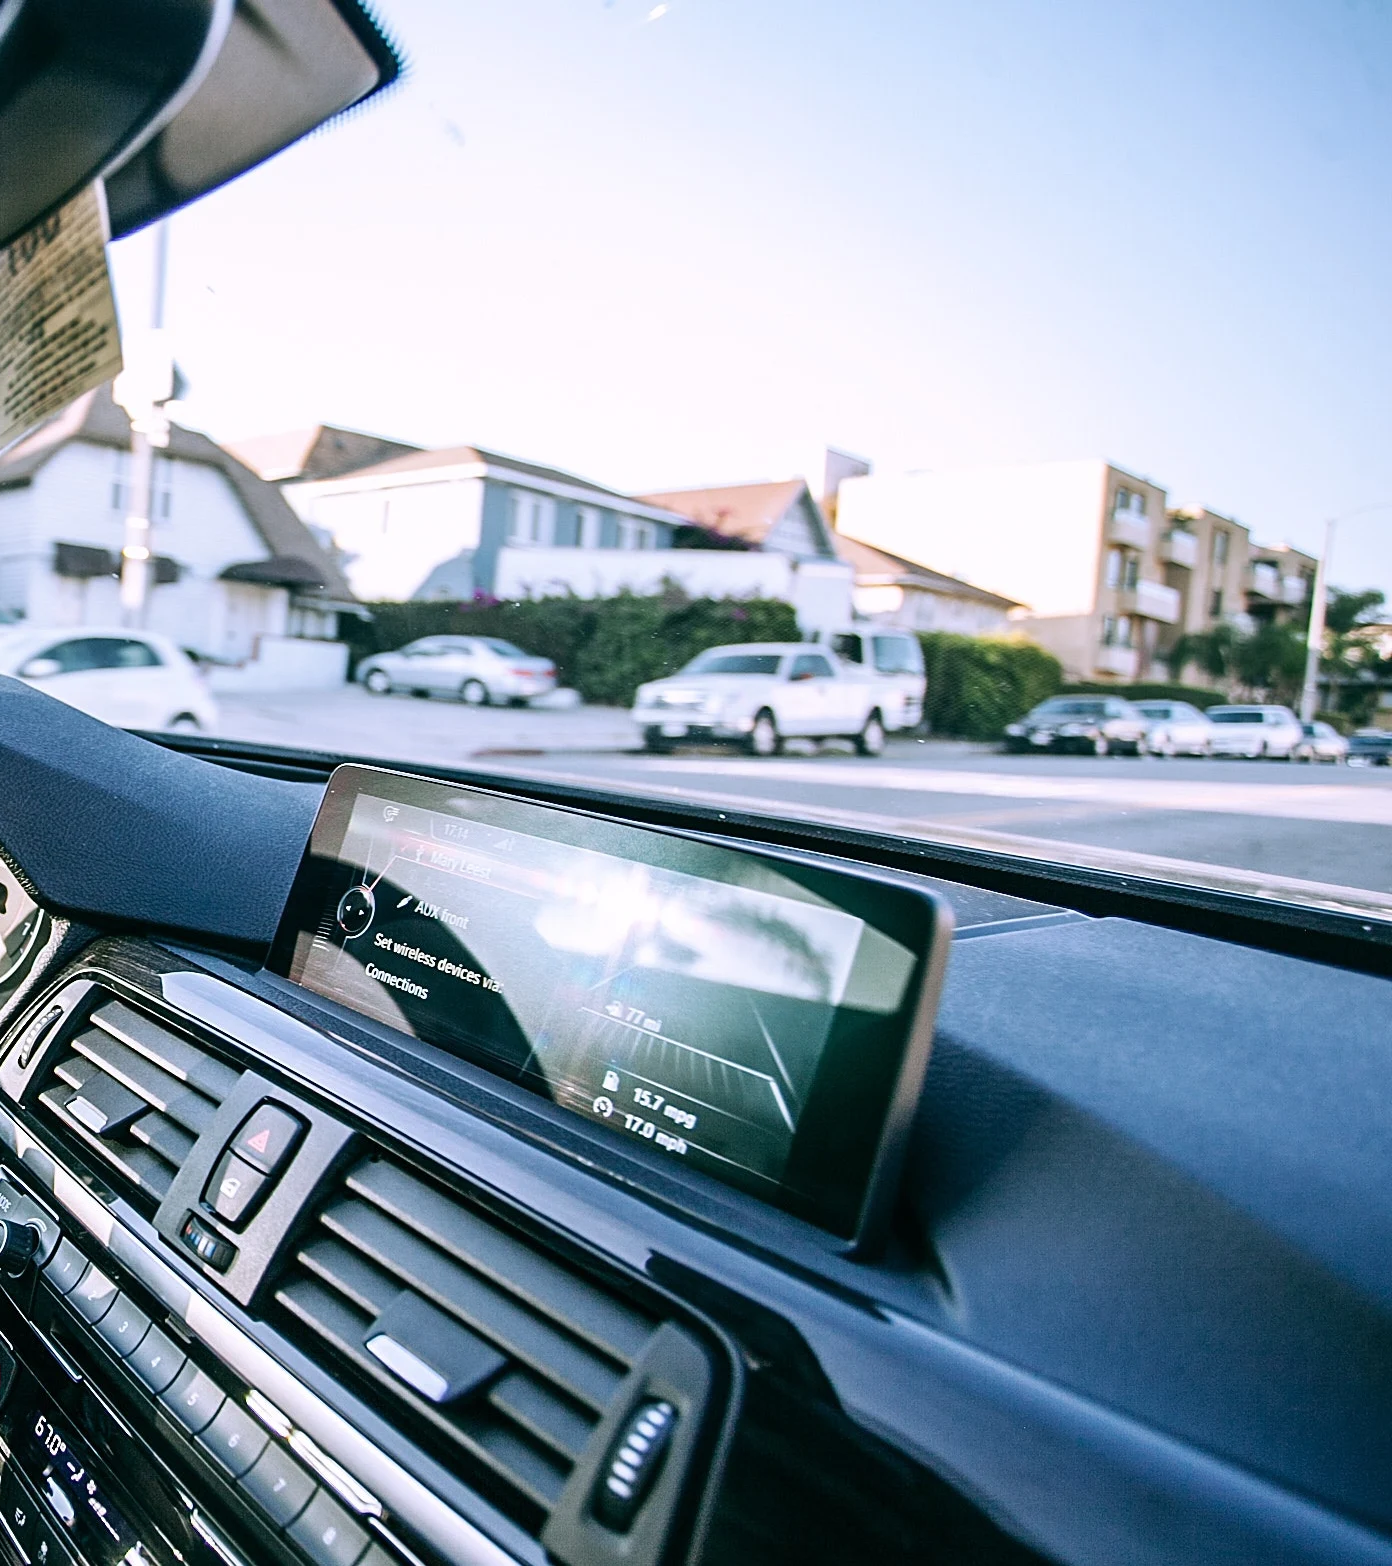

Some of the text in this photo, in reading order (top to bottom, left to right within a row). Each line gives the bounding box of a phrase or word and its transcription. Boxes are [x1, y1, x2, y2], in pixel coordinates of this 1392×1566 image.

[414, 900, 470, 930] AUX front
[373, 932, 505, 994] Set wireless devices via:
[365, 962, 429, 1000] Connections
[625, 1007, 662, 1033] 77 mi
[633, 1087, 697, 1130] 15.7 mpg
[624, 1113, 688, 1155] 17.0 mph
[63, 1262, 71, 1273] 1
[118, 1320, 129, 1333] 3
[150, 1356, 161, 1368] 4
[187, 1392, 200, 1406] 5
[227, 1433, 241, 1448] 6
[272, 1478, 287, 1493] 7
[322, 1526, 337, 1546] 8
